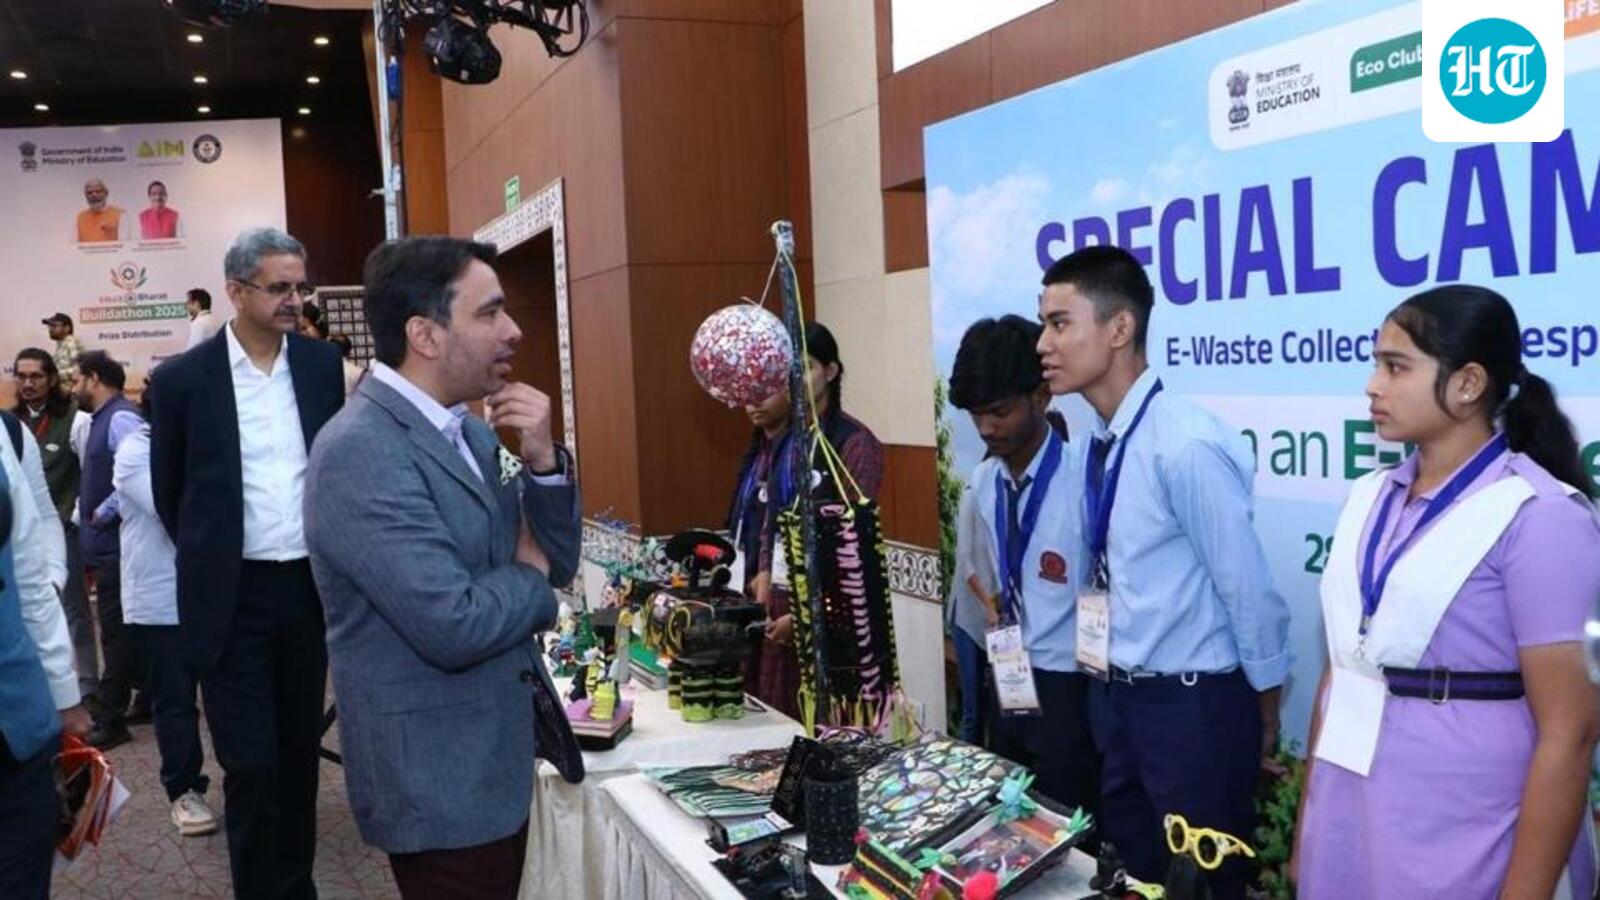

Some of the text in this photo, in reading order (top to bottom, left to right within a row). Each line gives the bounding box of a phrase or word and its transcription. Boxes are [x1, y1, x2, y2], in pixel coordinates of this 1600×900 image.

[1356, 59, 1385, 78] Eco
[1256, 73, 1314, 97] MINISTRY OF
[1256, 86, 1321, 114] EDUCATION
[82, 305, 186, 321] Buildathon 2025
[98, 332, 121, 341] Prize
[1166, 333, 1273, 366] E-Waste
[1270, 429, 1328, 478] an
